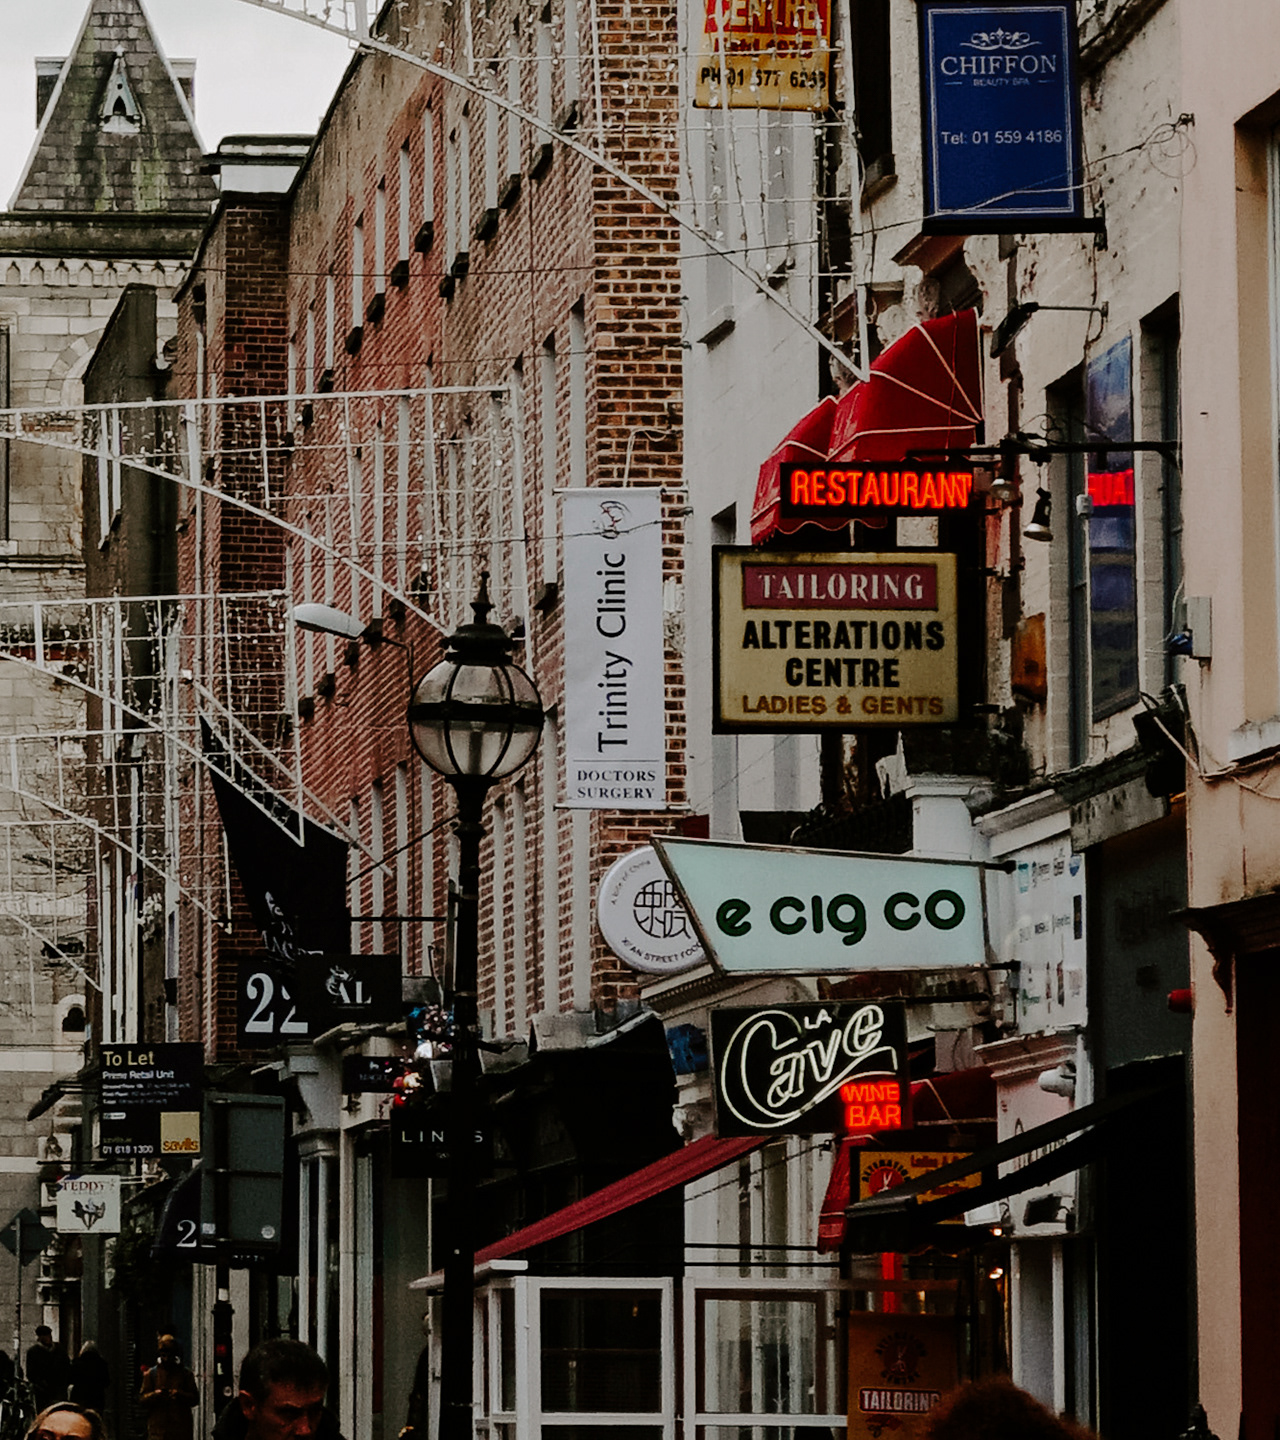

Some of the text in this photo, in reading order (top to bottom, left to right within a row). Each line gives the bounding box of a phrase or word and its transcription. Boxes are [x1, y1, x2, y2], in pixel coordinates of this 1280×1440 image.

[940, 54, 1057, 76] CHIFFON
[973, 77, 1009, 87] BEAUTY
[941, 129, 1063, 145] Tel: 01 559 4186
[791, 470, 974, 509] RESTAURANT
[757, 572, 924, 603] TAILORING
[742, 620, 945, 651] ALTERATIONS
[596, 553, 633, 753] Trinity Clinic
[785, 657, 900, 689] CENTRE
[742, 695, 945, 716] LADIES & GENTS
[576, 769, 657, 782] DOCTORS
[576, 786, 655, 800] SURGERY
[716, 898, 752, 937] e
[884, 889, 966, 931] co
[803, 1007, 833, 1030] LA
[102, 1049, 156, 1067] To Let
[720, 1004, 886, 1129] Cave
[155, 1069, 175, 1079] Unit
[842, 1083, 900, 1102] WINE
[848, 1103, 901, 1128] BAR
[401, 1130, 484, 1144] LINS
